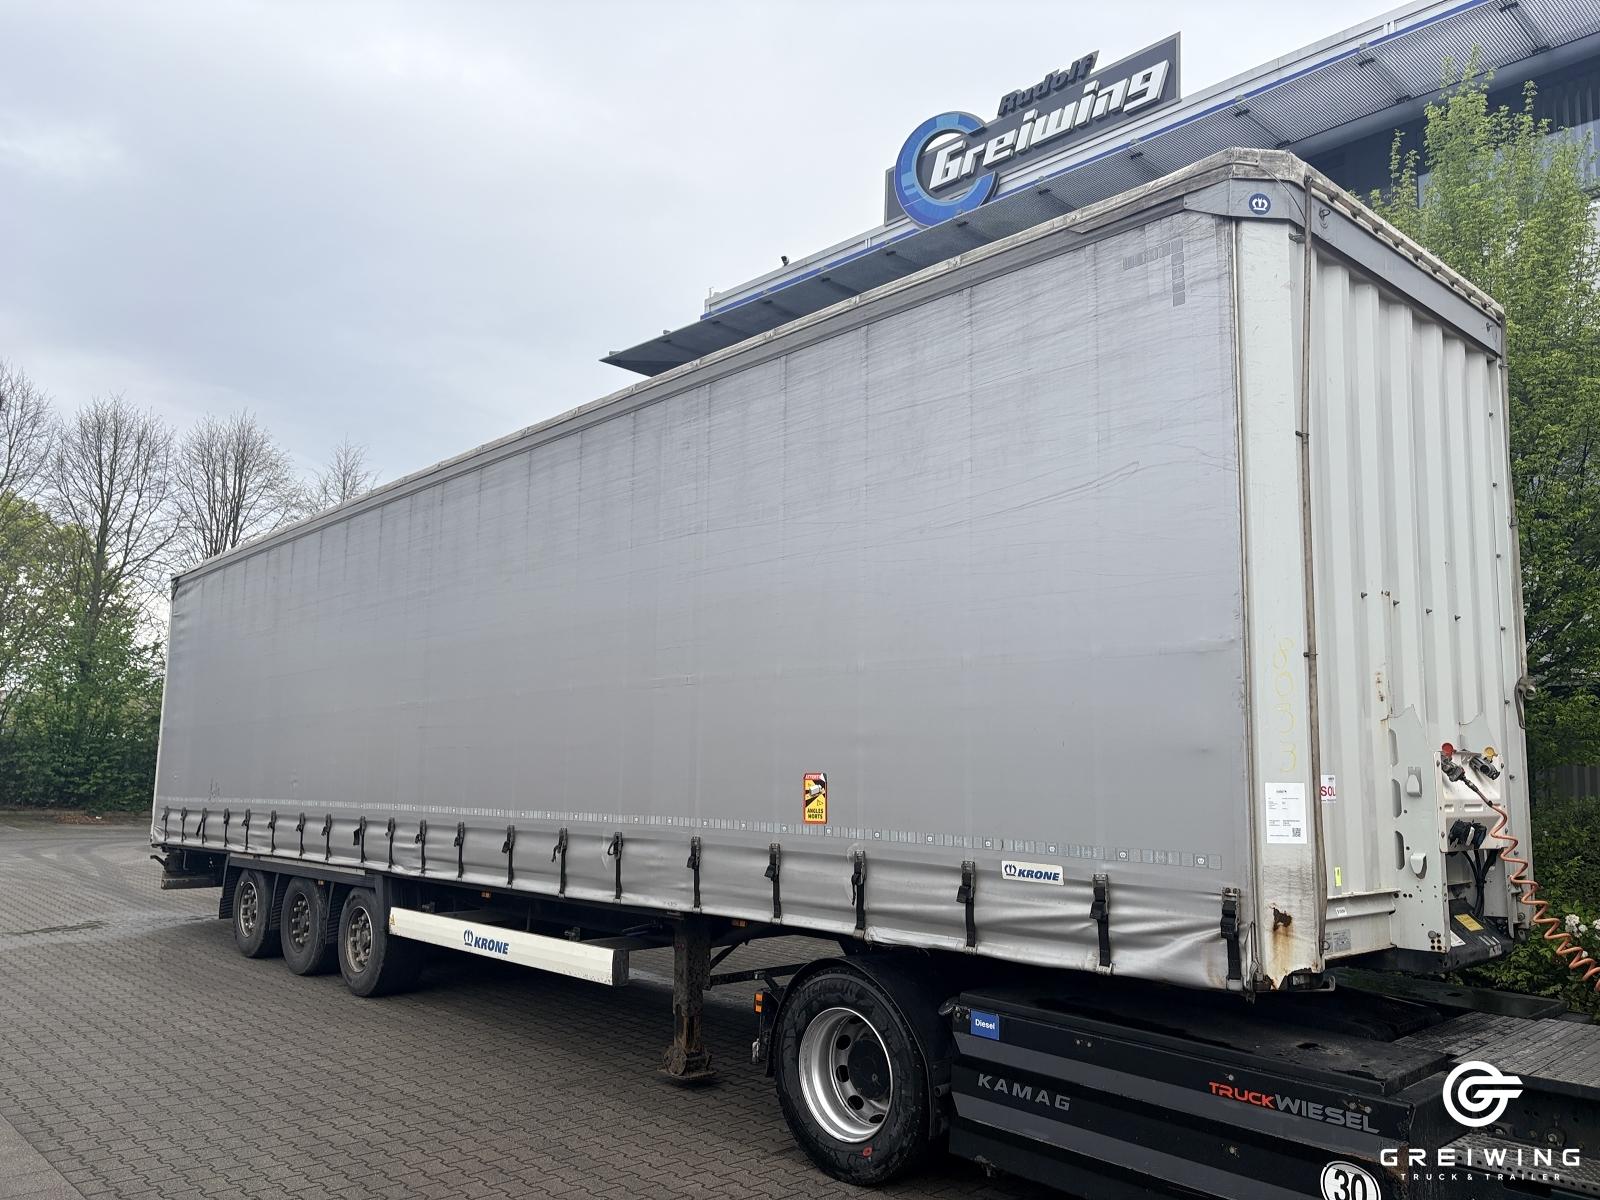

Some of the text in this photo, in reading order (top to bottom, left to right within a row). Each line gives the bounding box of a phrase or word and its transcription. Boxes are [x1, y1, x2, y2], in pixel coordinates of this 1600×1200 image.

[998, 50, 1099, 117] Rudolf
[929, 59, 1170, 191] Greiwing
[1017, 868, 1061, 882] KRONE
[474, 936, 510, 955] KRONE
[975, 1018, 996, 1030] Diesel
[977, 1073, 1071, 1111] KAMAG
[1208, 1081, 1380, 1134] TRUCKWIESEL
[1333, 1169, 1368, 1200] 30
